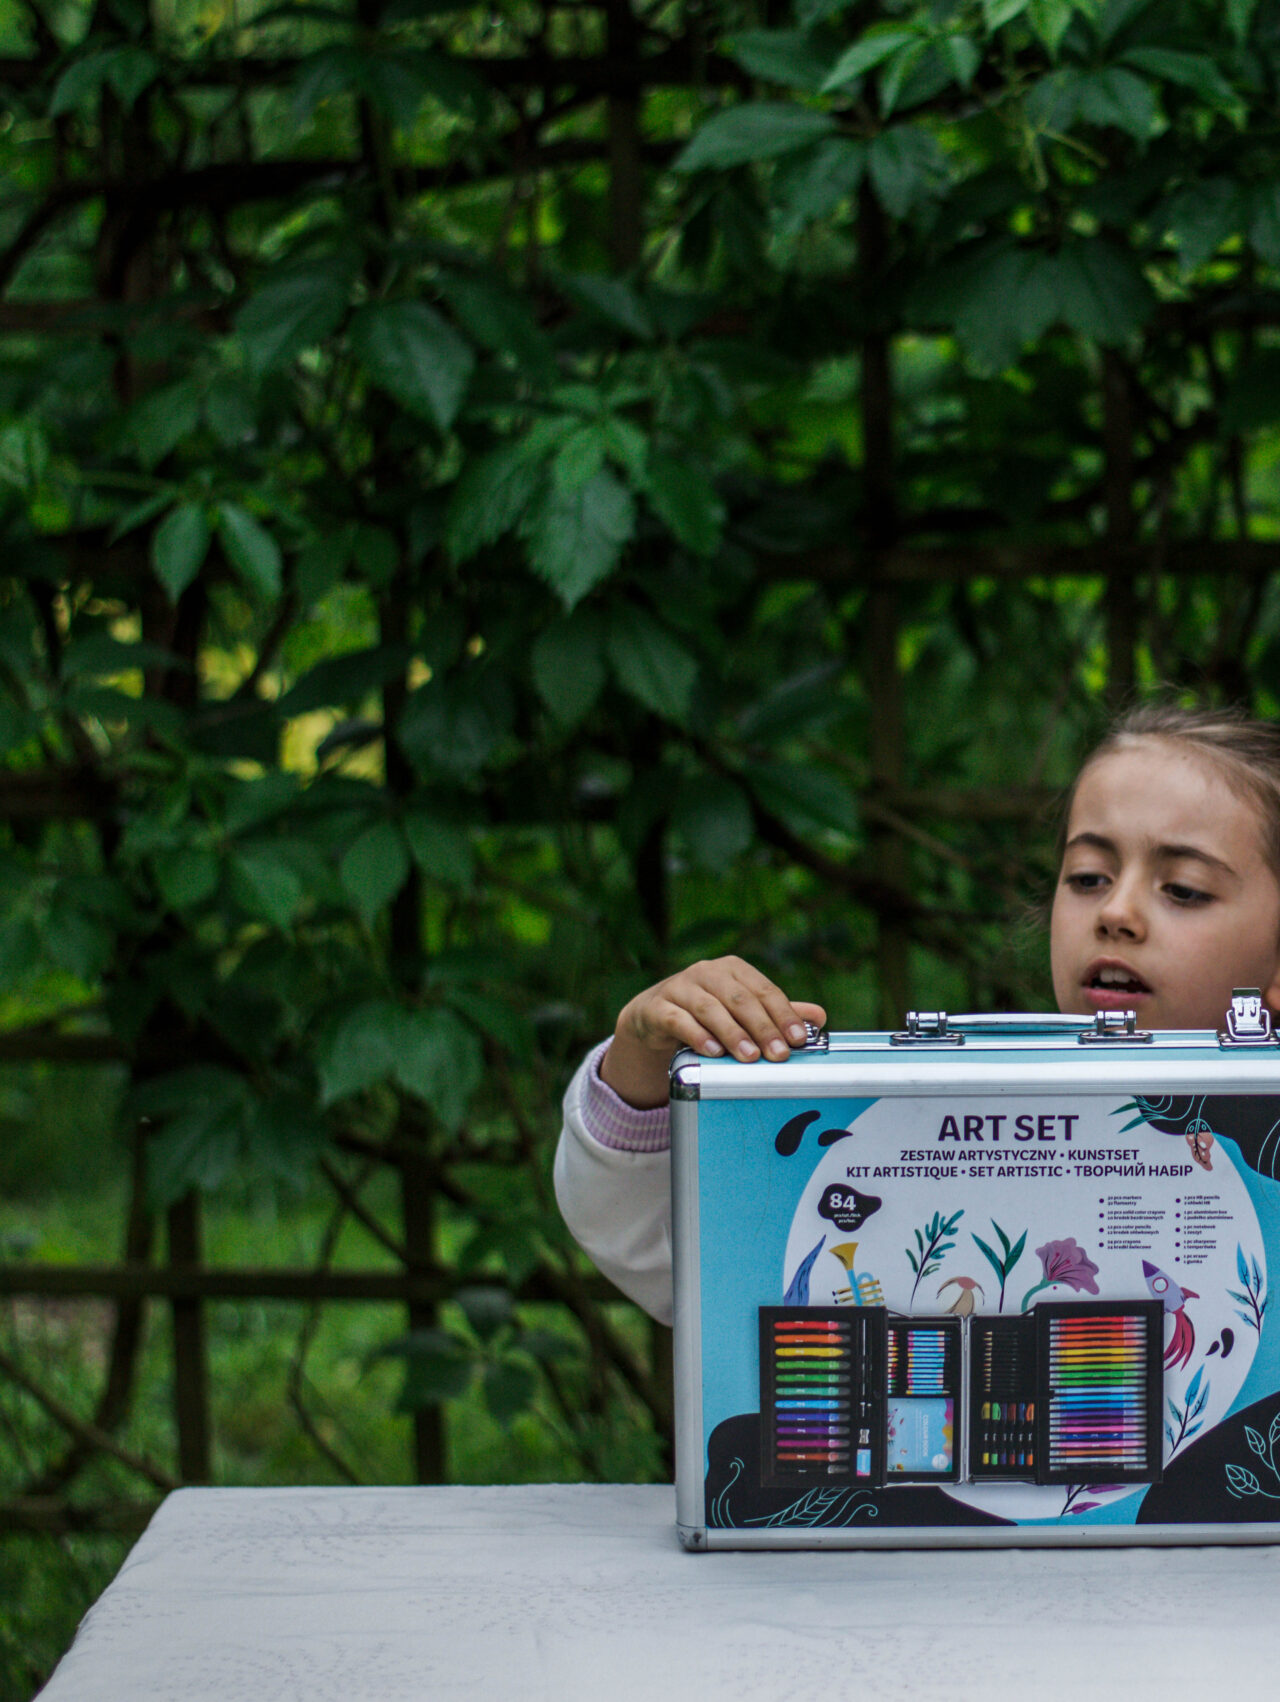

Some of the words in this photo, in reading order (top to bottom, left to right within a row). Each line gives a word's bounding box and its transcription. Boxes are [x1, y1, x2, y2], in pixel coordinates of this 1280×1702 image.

[938, 1115, 1007, 1141] ART
[1014, 1115, 1079, 1141] SET
[900, 1150, 955, 1161] ZESTAW
[958, 1150, 1056, 1161] ARTYSTYCZNY
[1068, 1150, 1140, 1160] KUNSTSET
[847, 1167, 870, 1177] KIT
[873, 1166, 958, 1180] ARTISTIQUE
[969, 1166, 994, 1177] SET
[997, 1166, 1062, 1177] ARTISTIC
[1074, 1163, 1145, 1177] ТВОРЧИЙ
[1149, 1165, 1193, 1176] НАБІР
[830, 1192, 857, 1211] 84
